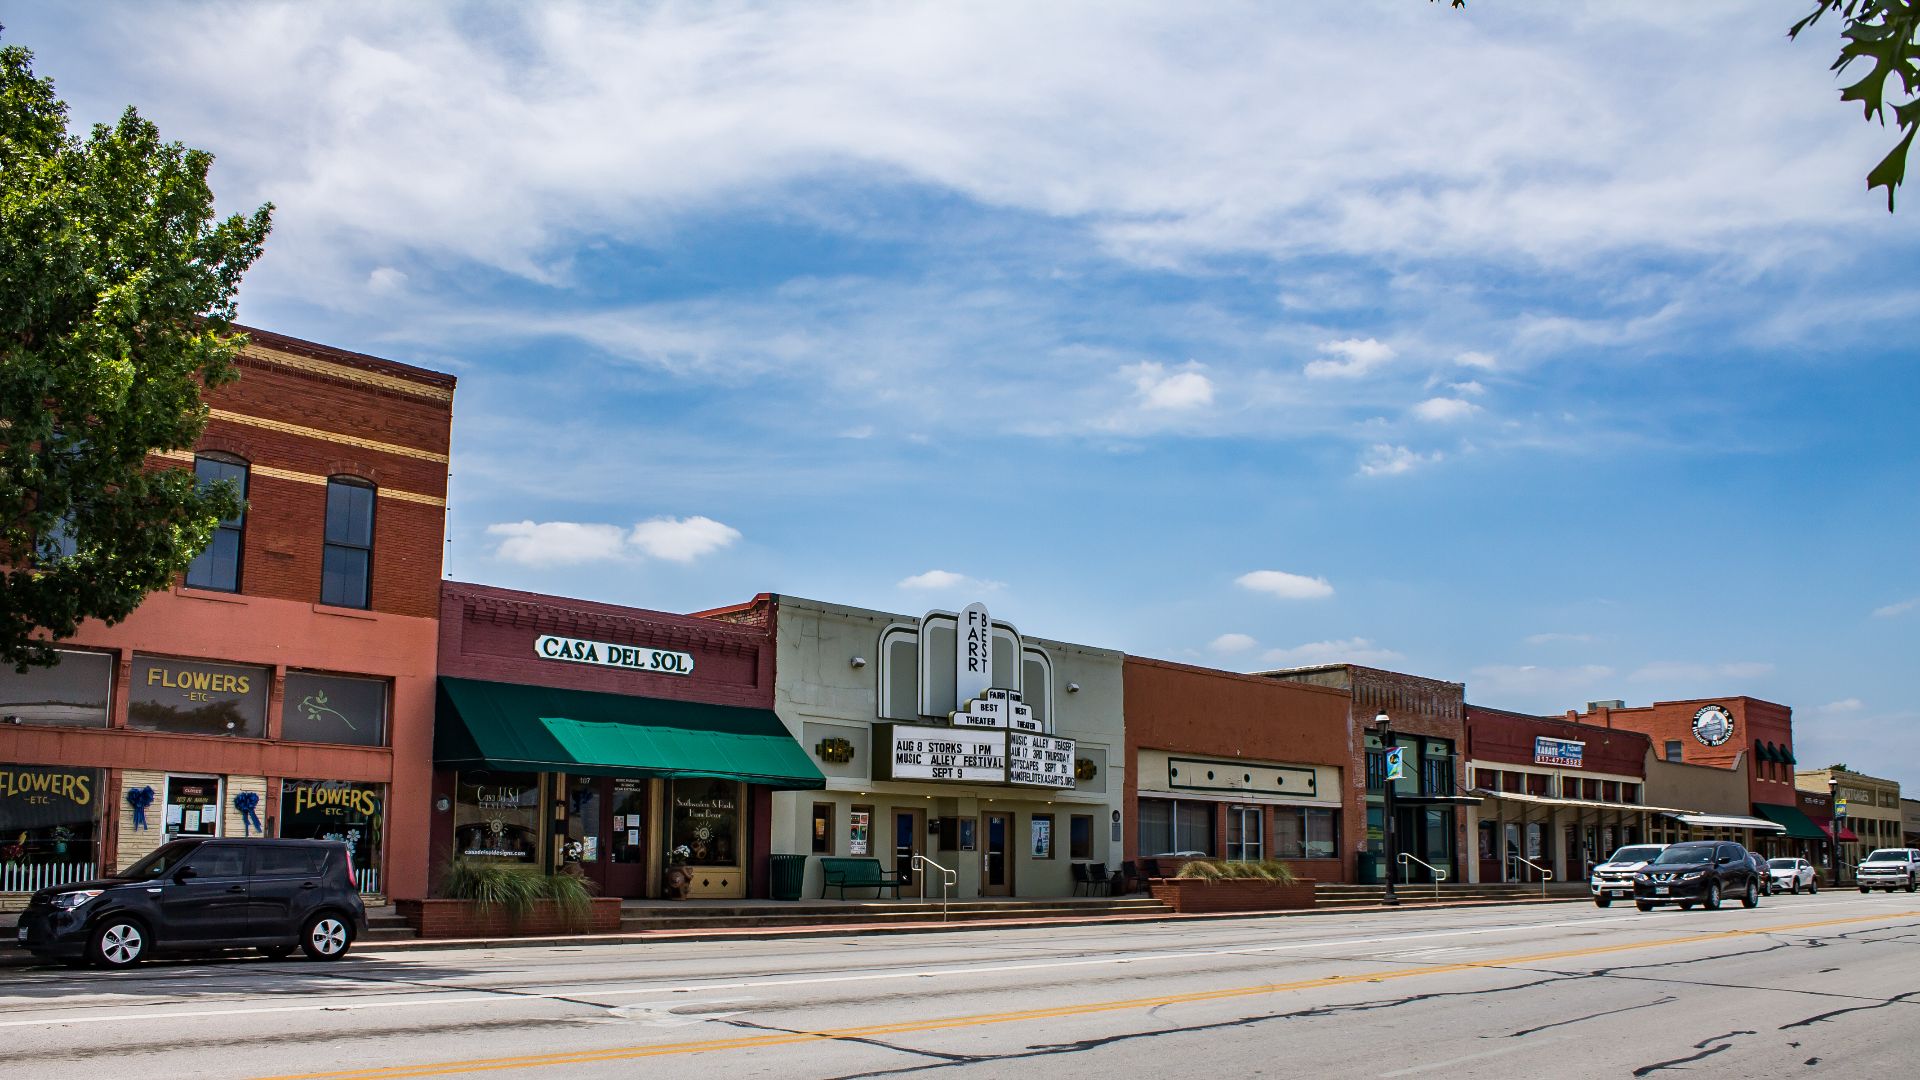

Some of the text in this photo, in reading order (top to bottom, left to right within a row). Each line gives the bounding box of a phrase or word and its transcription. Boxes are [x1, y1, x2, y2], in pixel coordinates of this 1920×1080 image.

[967, 611, 979, 672] FARR
[543, 638, 688, 673] CASA DEL SOL
[147, 667, 250, 694] FLOWERS
[989, 691, 1006, 700] FARR
[980, 703, 998, 712] BEST
[1015, 707, 1027, 716] BEST
[966, 715, 996, 726] THEATER
[1016, 720, 1036, 730] THEATER
[896, 740, 914, 752] AUG
[916, 741, 923, 752] 8
[928, 742, 963, 754] STORKS
[978, 744, 992, 755] PM
[1011, 734, 1028, 746] MUSIC
[1032, 737, 1050, 748] ALLEY
[1022, 748, 1028, 758] 17
[1033, 749, 1043, 760] 3RD
[1045, 750, 1070, 763] THURSDAY
[1537, 745, 1559, 756] KARATE
[896, 753, 1004, 769] MUSIC ALLEY FESTIVAL
[1011, 759, 1039, 771] ARTSCAPES
[1044, 762, 1057, 773] SEPT
[932, 767, 963, 779] SEPT 9
[0, 771, 90, 805] FLOWERS
[477, 785, 496, 802] Casa
[295, 786, 376, 816] FLOWERS
